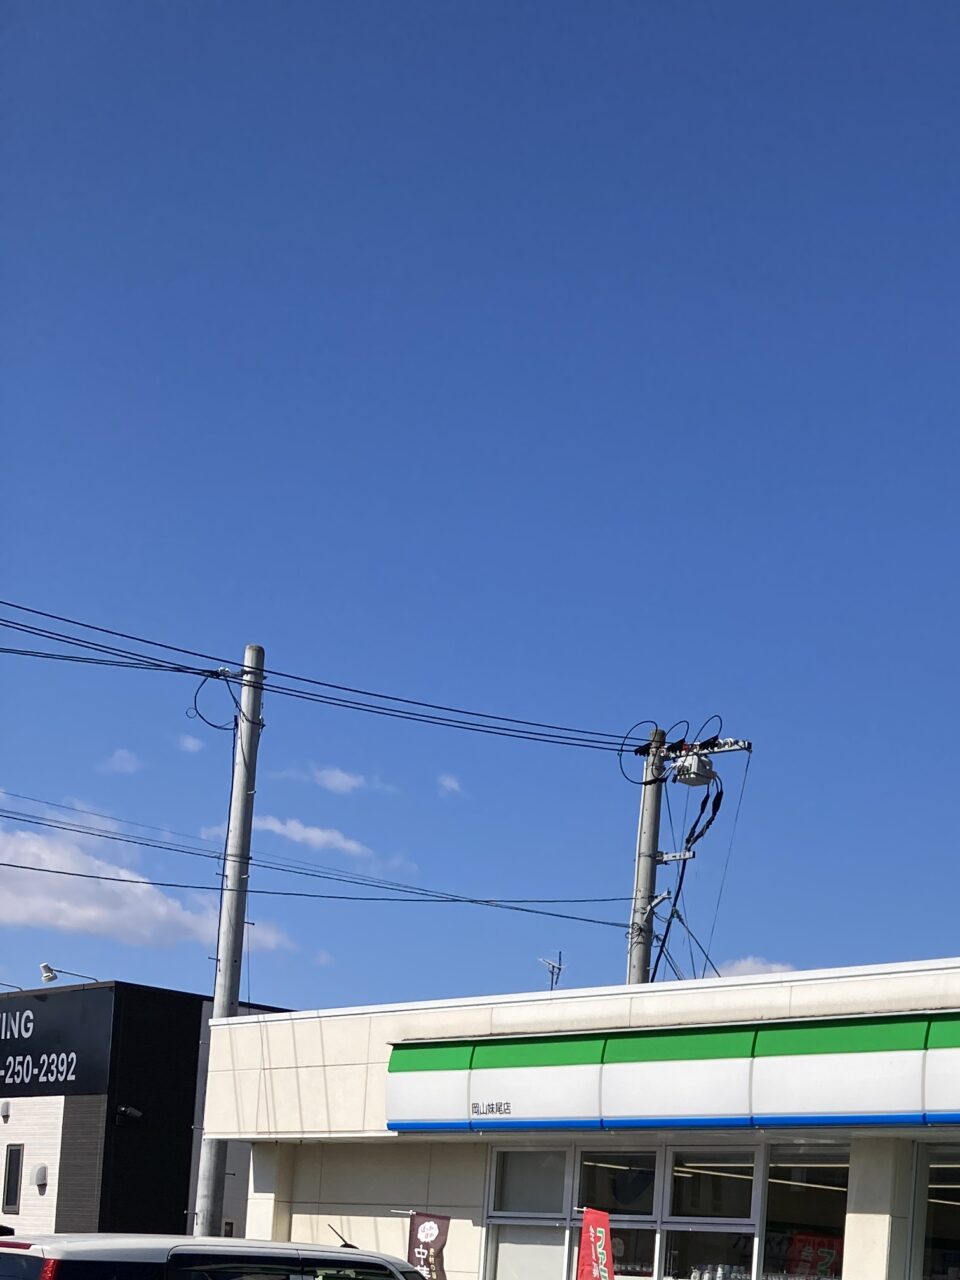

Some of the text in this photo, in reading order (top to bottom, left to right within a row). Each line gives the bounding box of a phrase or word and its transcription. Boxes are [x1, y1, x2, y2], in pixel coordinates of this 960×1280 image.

[0, 1009, 34, 1039] ING
[0, 1052, 77, 1084] -250-2392
[472, 1102, 511, 1115] 岡山妹尾店
